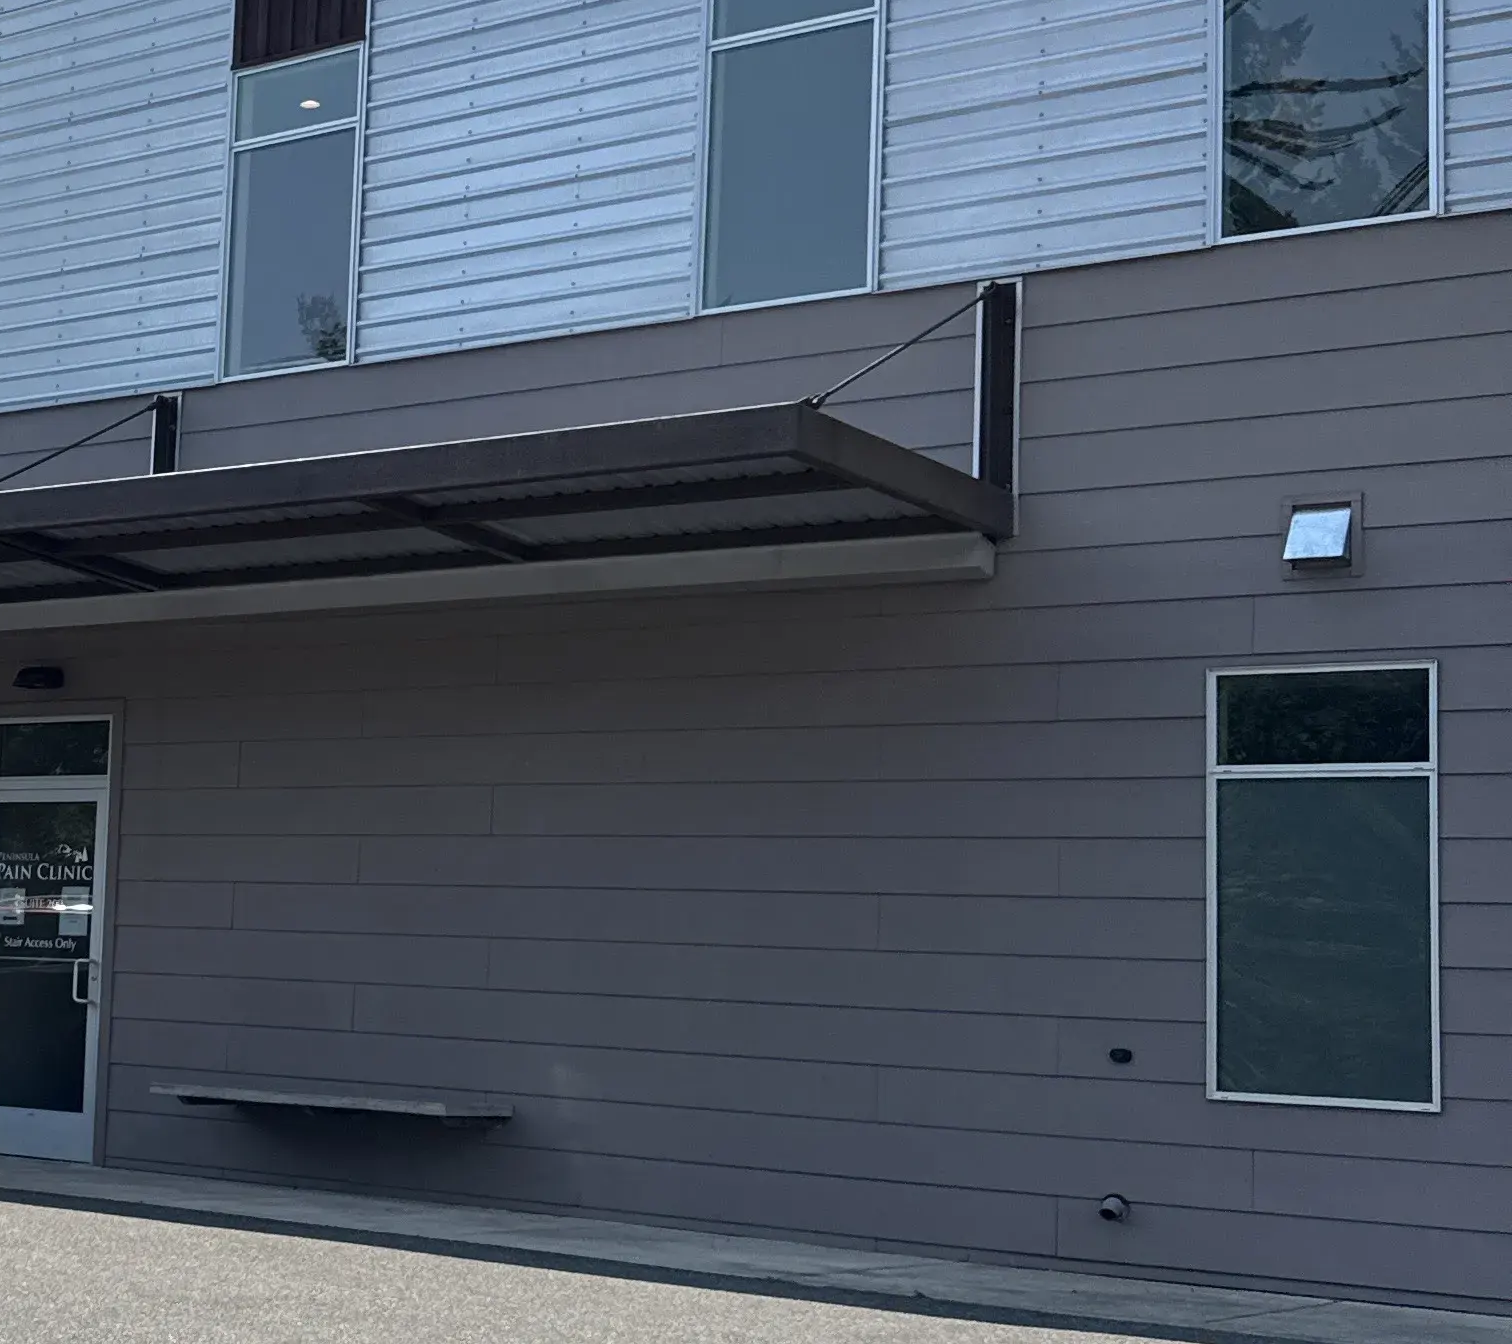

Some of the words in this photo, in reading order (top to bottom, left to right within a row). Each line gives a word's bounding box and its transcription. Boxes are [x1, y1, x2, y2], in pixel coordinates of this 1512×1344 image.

[36, 862, 93, 881] CLINIC
[4, 936, 23, 947] Stair
[24, 936, 54, 949] Access
[55, 937, 77, 952] Only
